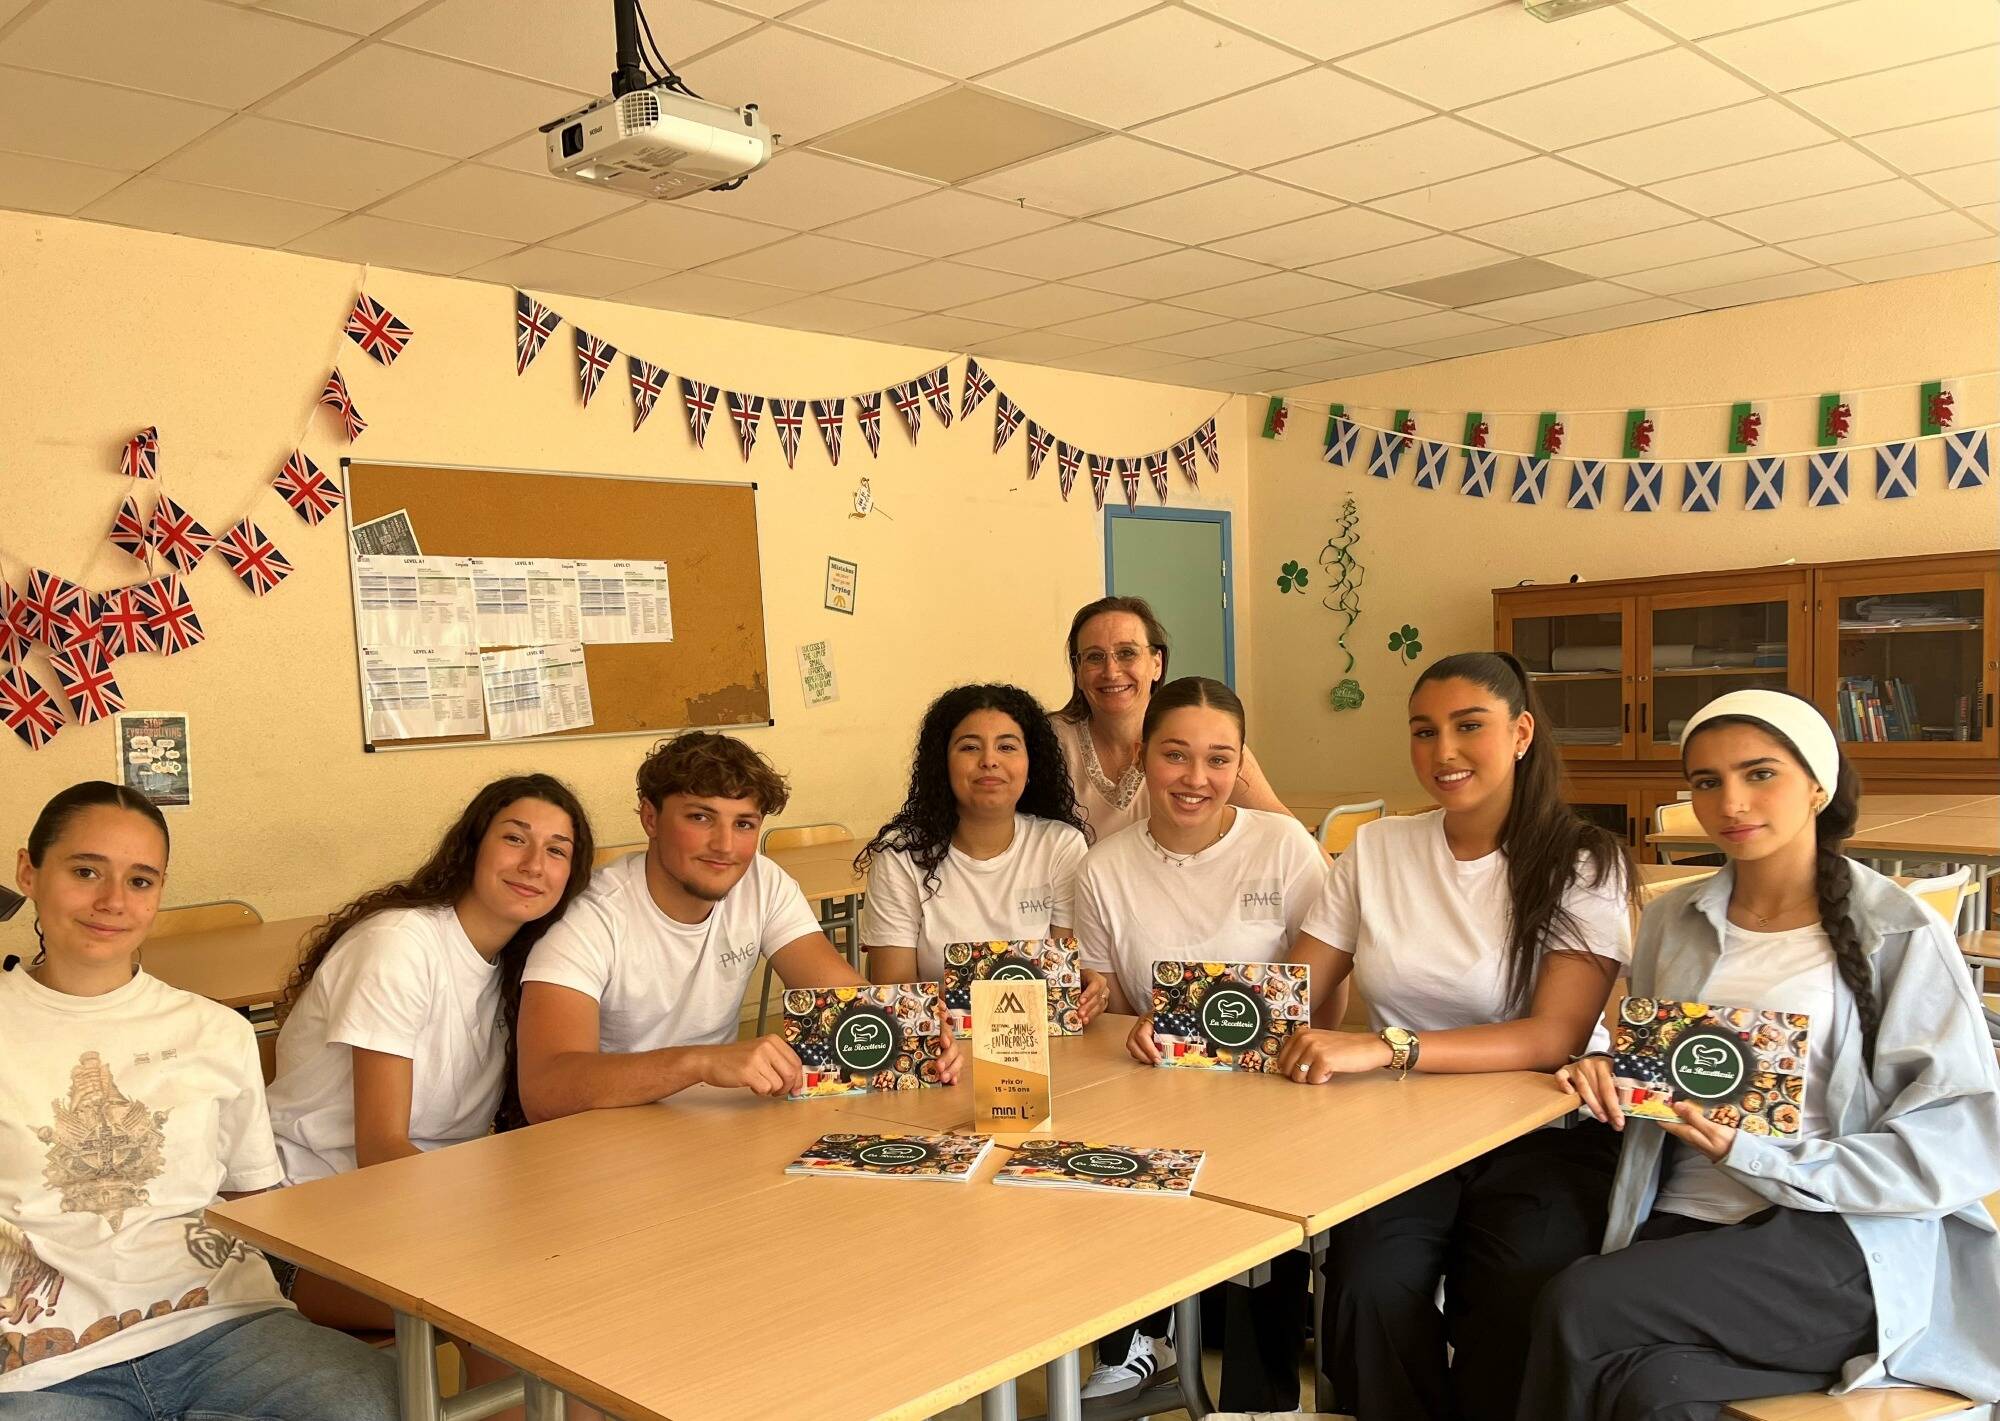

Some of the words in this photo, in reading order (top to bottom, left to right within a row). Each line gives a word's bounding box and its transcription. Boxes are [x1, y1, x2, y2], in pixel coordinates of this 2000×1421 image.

[831, 584, 851, 596] Trying
[144, 719, 163, 728] STOP
[1221, 1019, 1253, 1028] Recetterie
[992, 1033, 1034, 1050] ENTREPRISES
[854, 1043, 886, 1051] Recetterie
[1678, 1065, 1692, 1073] La
[1693, 1067, 1735, 1079] Recetterie
[992, 1107, 1016, 1115] mini
